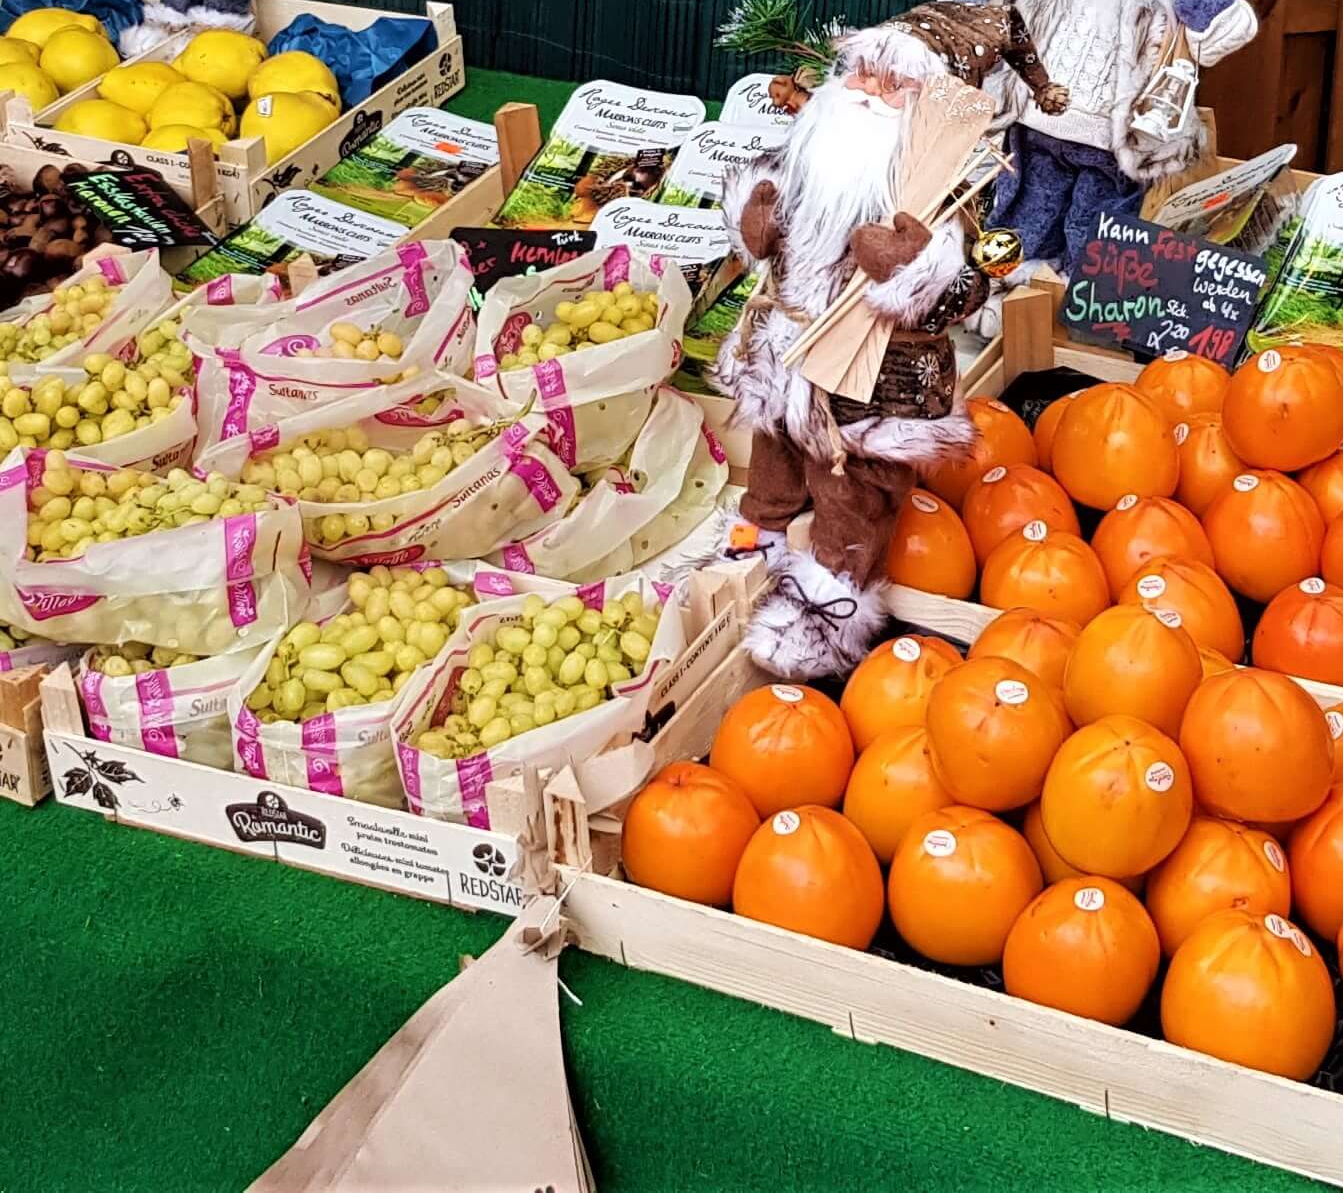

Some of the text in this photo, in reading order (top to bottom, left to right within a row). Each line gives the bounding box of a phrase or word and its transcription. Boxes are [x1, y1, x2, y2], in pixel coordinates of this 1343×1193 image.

[551, 230, 584, 246] Türk
[1098, 212, 1150, 245] Kann
[1194, 250, 1266, 287] gegessen
[1082, 240, 1159, 295] Süße
[1066, 280, 1166, 322] Sharon
[268, 383, 320, 402] Sultanas
[452, 467, 501, 509] Sultanas
[233, 811, 321, 842] Romantic
